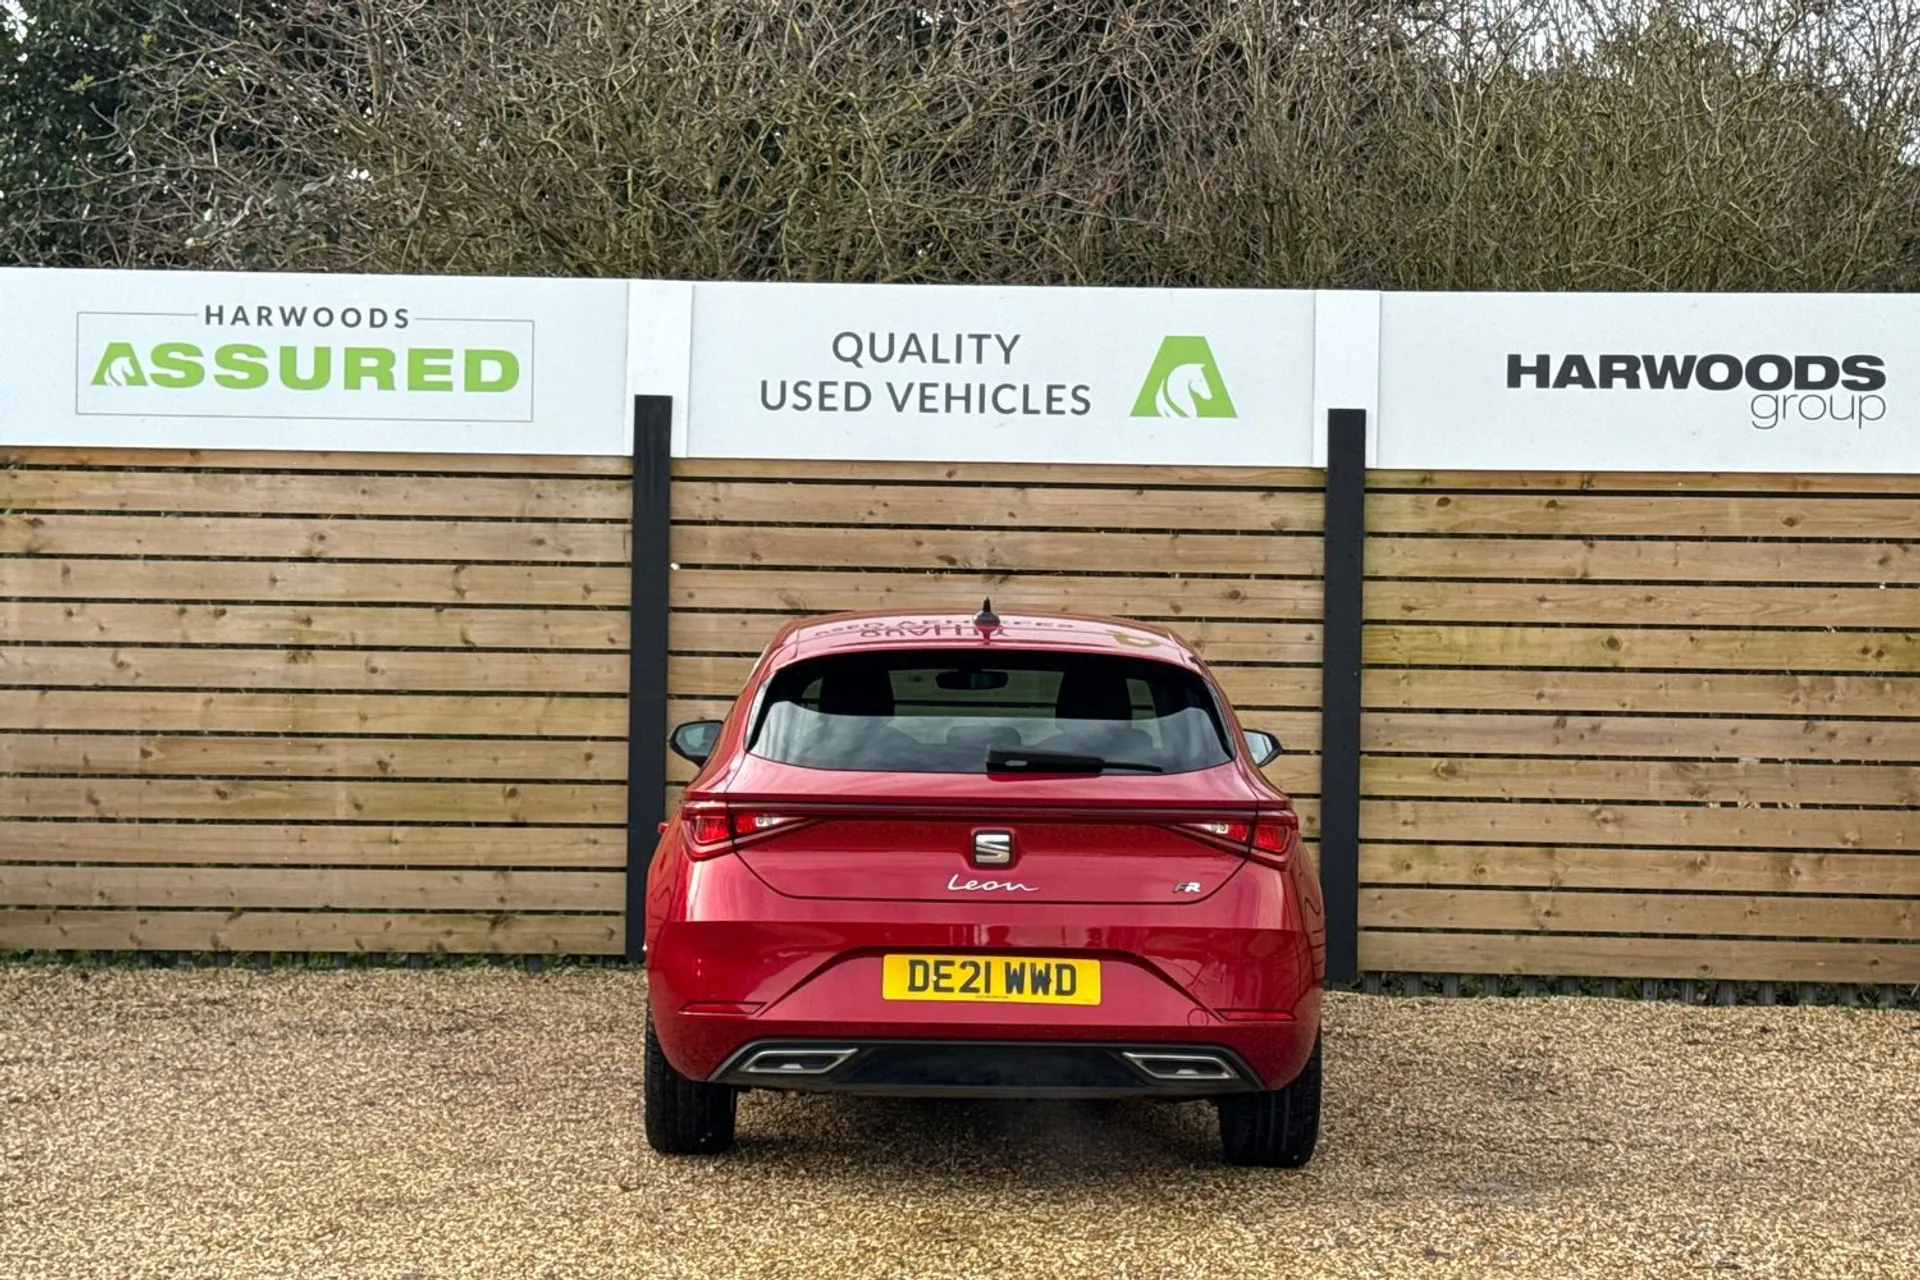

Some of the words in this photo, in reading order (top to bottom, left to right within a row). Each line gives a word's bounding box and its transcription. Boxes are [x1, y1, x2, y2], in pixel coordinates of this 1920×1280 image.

[204, 304, 411, 329] HARWOODS
[90, 341, 520, 393] ASSURED
[832, 331, 1021, 368] QUALITY
[1506, 353, 1887, 392] HARWOODS
[760, 379, 872, 412] USED
[885, 382, 1091, 416] VEHICLES
[1750, 393, 1887, 430] group
[947, 873, 1039, 892] Leon
[1173, 881, 1201, 893] FR
[908, 959, 992, 993] DE21
[1004, 961, 1077, 997] WWD
